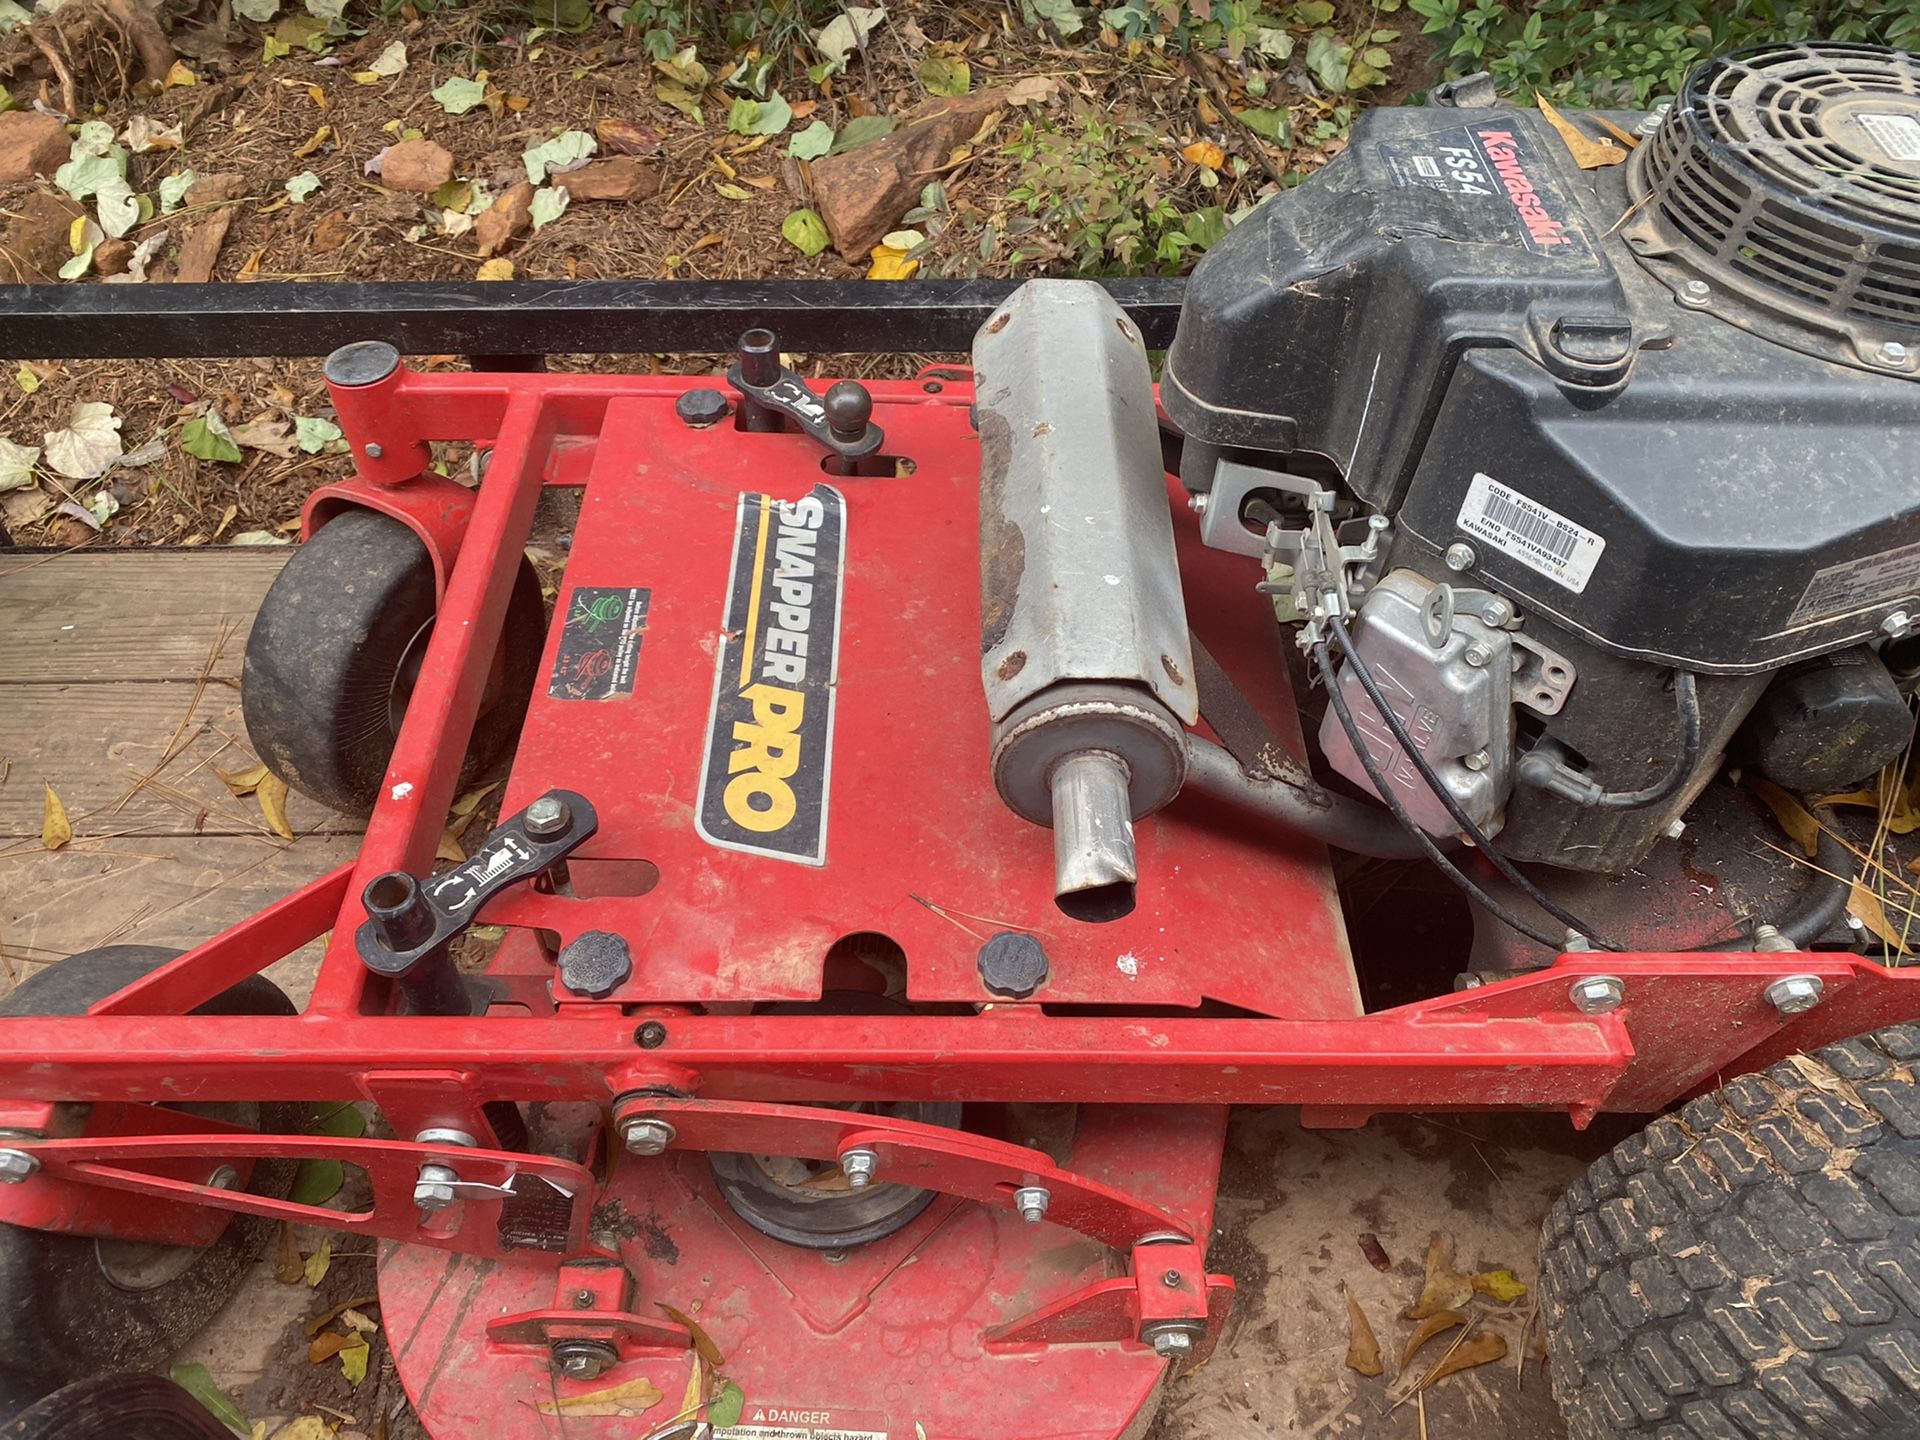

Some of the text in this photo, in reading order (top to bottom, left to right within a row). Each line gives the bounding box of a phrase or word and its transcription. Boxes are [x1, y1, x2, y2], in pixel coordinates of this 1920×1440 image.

[1477, 131, 1571, 245] Kawasaki
[1488, 484, 1511, 501] CODE
[1480, 517, 1501, 532] E/NO
[1463, 518, 1507, 547] KAWASAKI
[1517, 549, 1553, 572] ASSEMBLED
[1566, 576, 1580, 587] USA
[723, 497, 823, 832] SNAPPER PRO
[768, 1409, 831, 1425] DANGER
[776, 1430, 808, 1439] thrown
